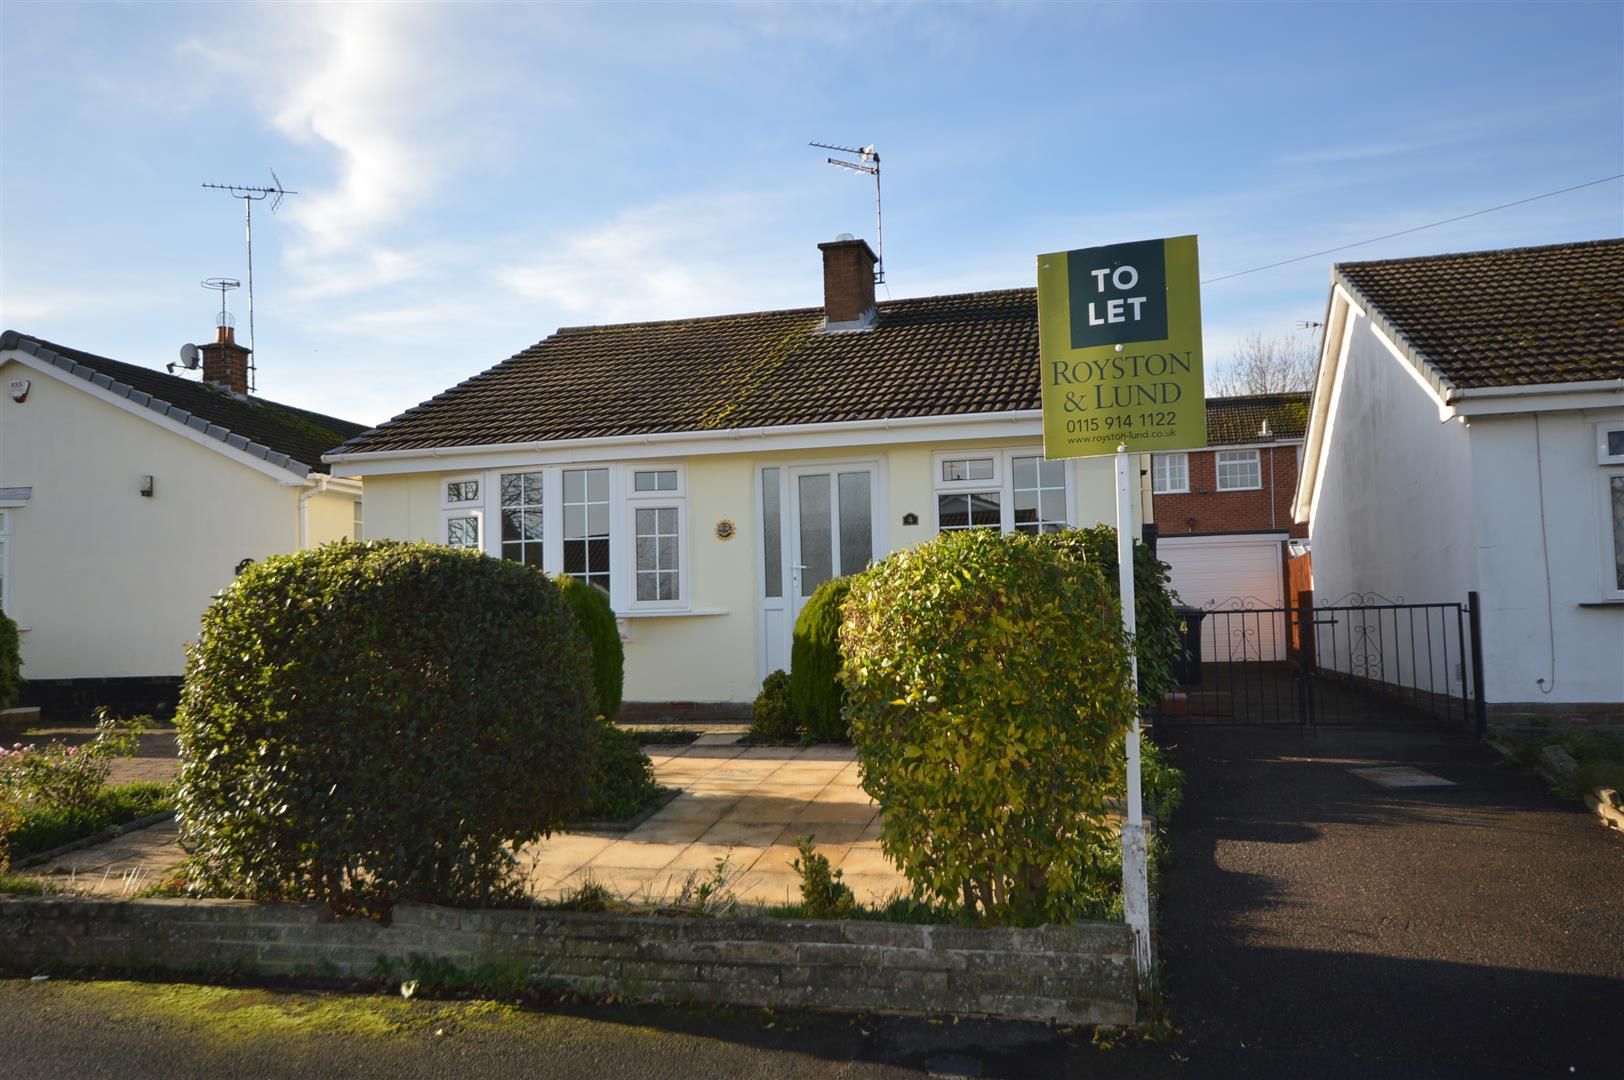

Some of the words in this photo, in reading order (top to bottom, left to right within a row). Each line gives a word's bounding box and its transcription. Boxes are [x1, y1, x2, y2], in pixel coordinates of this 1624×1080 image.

[1091, 265, 1139, 292] TO
[1088, 296, 1147, 326] LET
[1052, 352, 1193, 386] ROYSTON
[1063, 391, 1088, 413] &
[1094, 382, 1182, 410] LUND
[1066, 419, 1099, 433] 0115
[1105, 415, 1133, 430] 914
[1139, 412, 1176, 427] 1122
[1068, 428, 1176, 444] www.royston-lund.co.uk
[1179, 620, 1188, 634] 4
